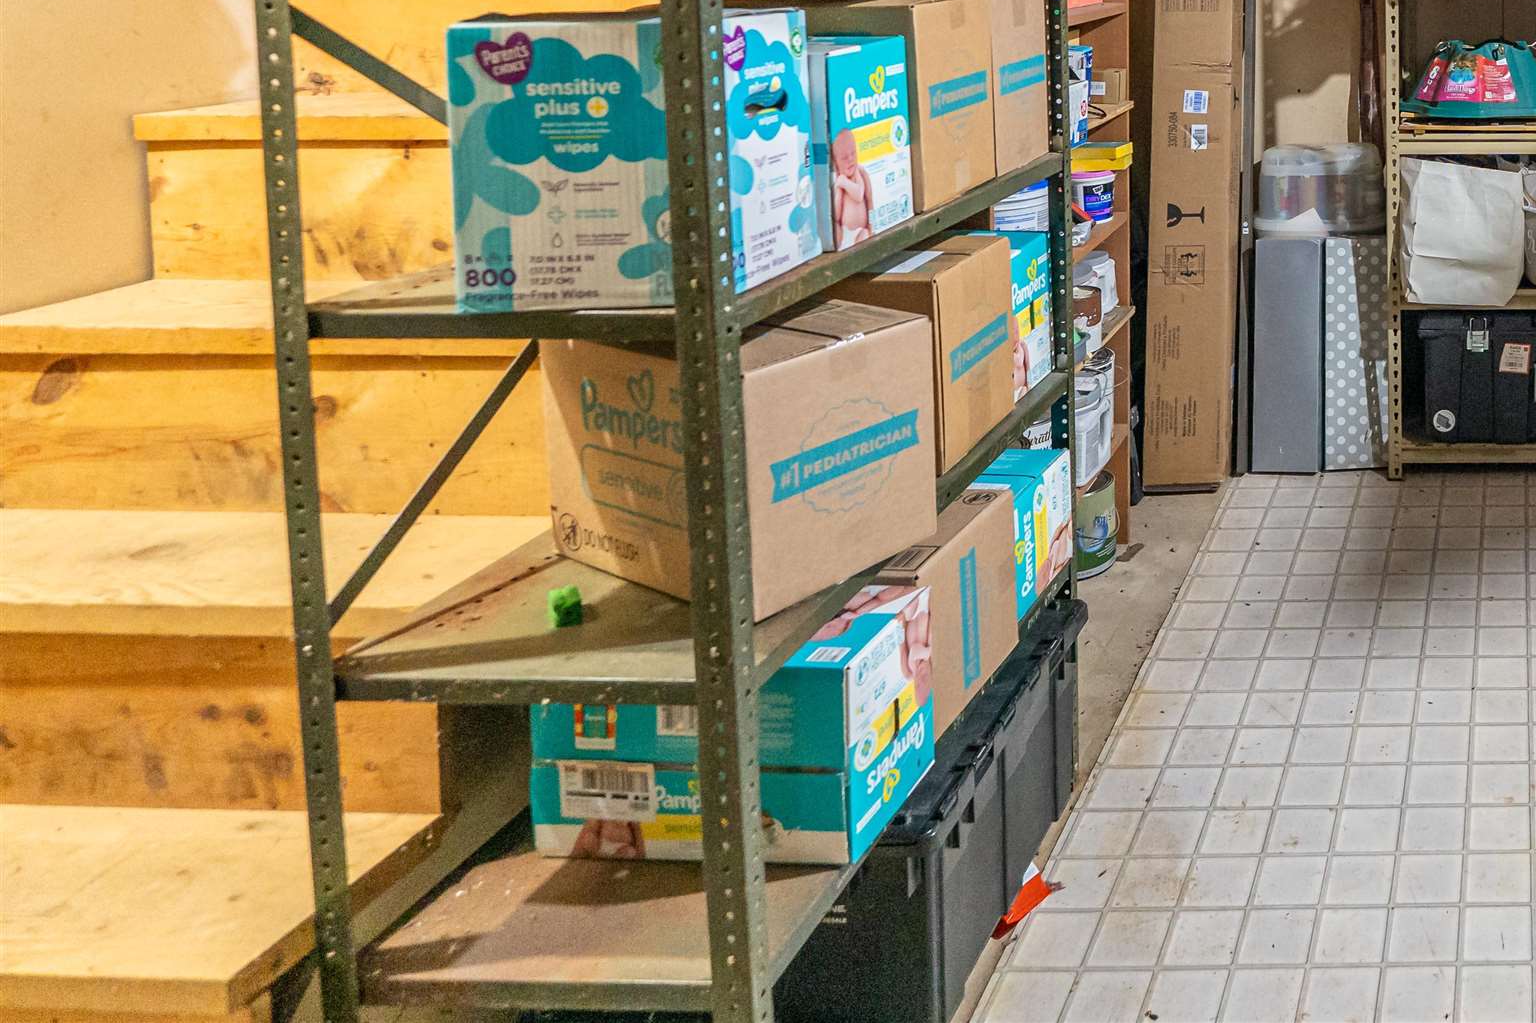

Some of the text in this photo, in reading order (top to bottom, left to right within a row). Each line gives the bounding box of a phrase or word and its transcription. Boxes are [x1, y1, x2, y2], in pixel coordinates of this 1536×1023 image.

[526, 79, 621, 97] sensitive
[535, 101, 580, 119] plus
[844, 87, 898, 123] Pampers
[554, 140, 599, 154] wipes
[465, 268, 517, 287] 800
[1012, 273, 1046, 308] Pampers
[464, 289, 599, 302] Fragrance-Free Wipes
[580, 377, 684, 453] Pampers
[780, 428, 914, 488] #1 PEDIATRICIAN
[1021, 510, 1034, 599] Pampers
[867, 714, 924, 794] Pampers
[655, 785, 701, 814] Pamp
